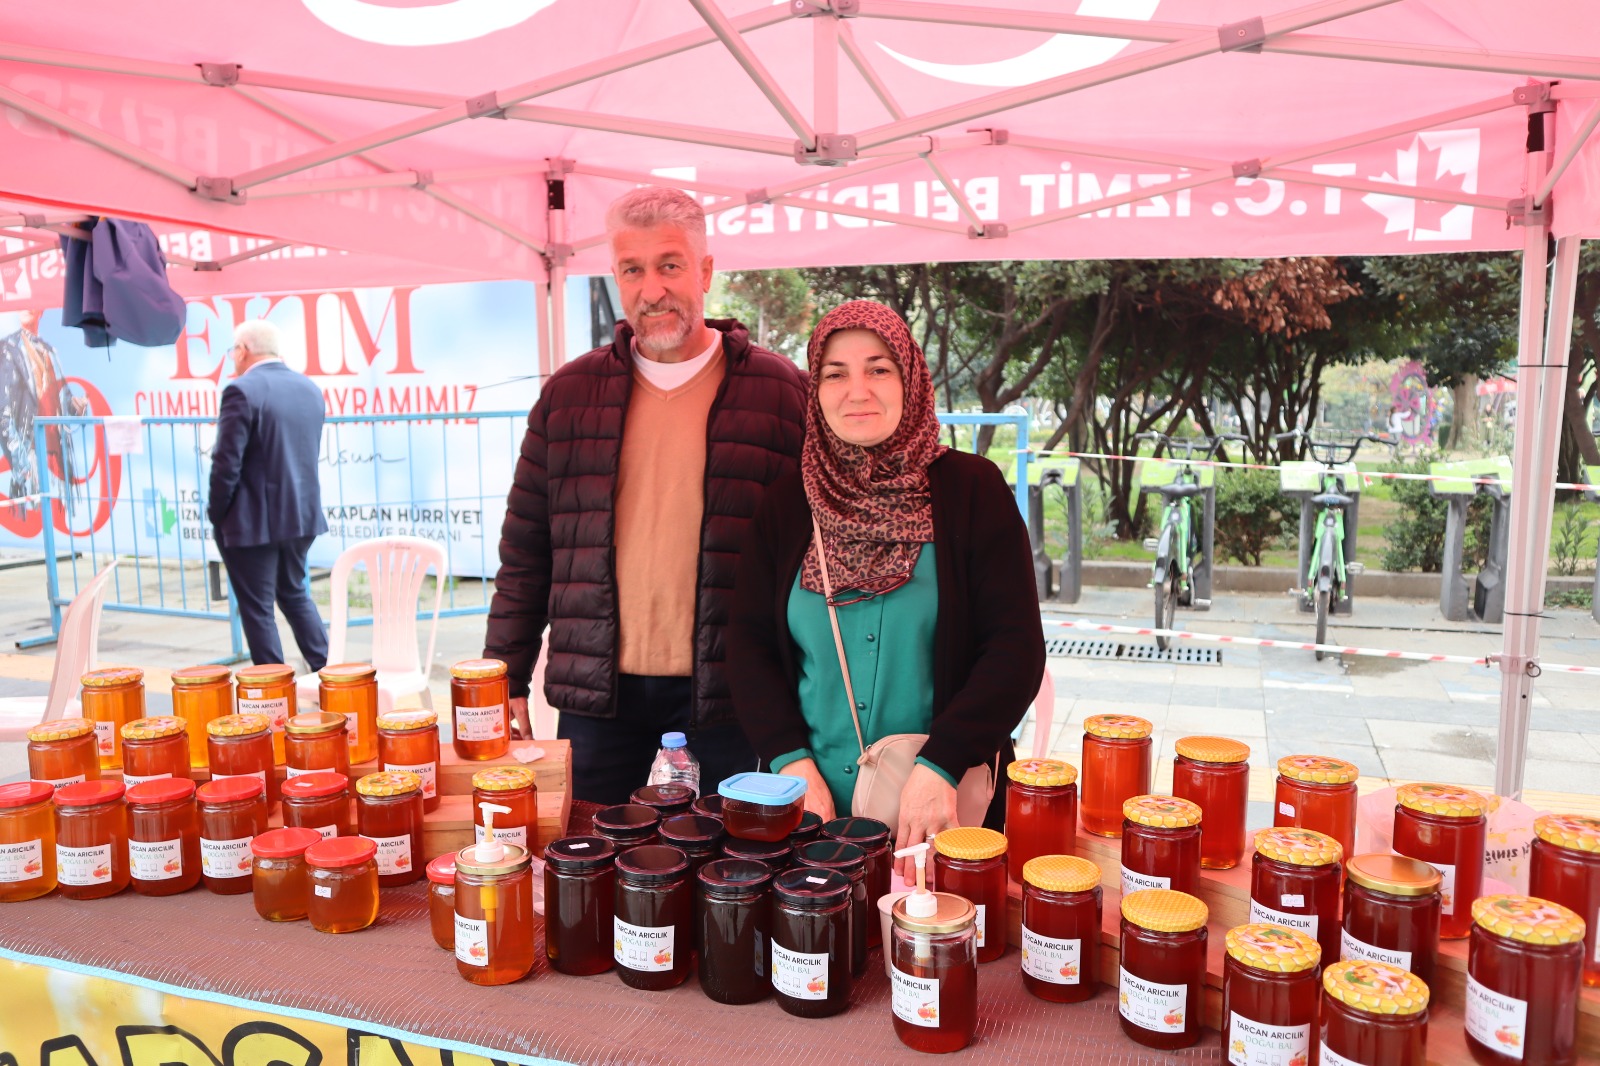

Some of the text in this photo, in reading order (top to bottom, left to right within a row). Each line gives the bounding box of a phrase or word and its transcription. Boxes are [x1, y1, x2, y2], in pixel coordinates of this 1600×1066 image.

[134, 384, 479, 426] CUMHU AYRAMIMIZ
[327, 506, 392, 521] KAPLAN
[7, 844, 36, 854] ARICILIK
[222, 842, 248, 850] ARICILIK
[77, 850, 104, 858] ARICILIK
[1135, 878, 1163, 888] ARICILIK
[1254, 906, 1276, 922] TARCAN
[1277, 917, 1310, 928] ARICILIK
[617, 922, 637, 936] TARCAN
[1044, 942, 1073, 951] ARICILIK
[1343, 936, 1402, 964] TARCAN ARICILIK
[792, 957, 822, 965] ARICILIK
[903, 979, 931, 991] ARICILIK
[1123, 974, 1180, 997] TARCAN ARICILIK
[1480, 992, 1515, 1013] ARICILIK
[1237, 1020, 1304, 1040] TARCAN ARICILIK
[1245, 1034, 1275, 1048] DOĞAL
